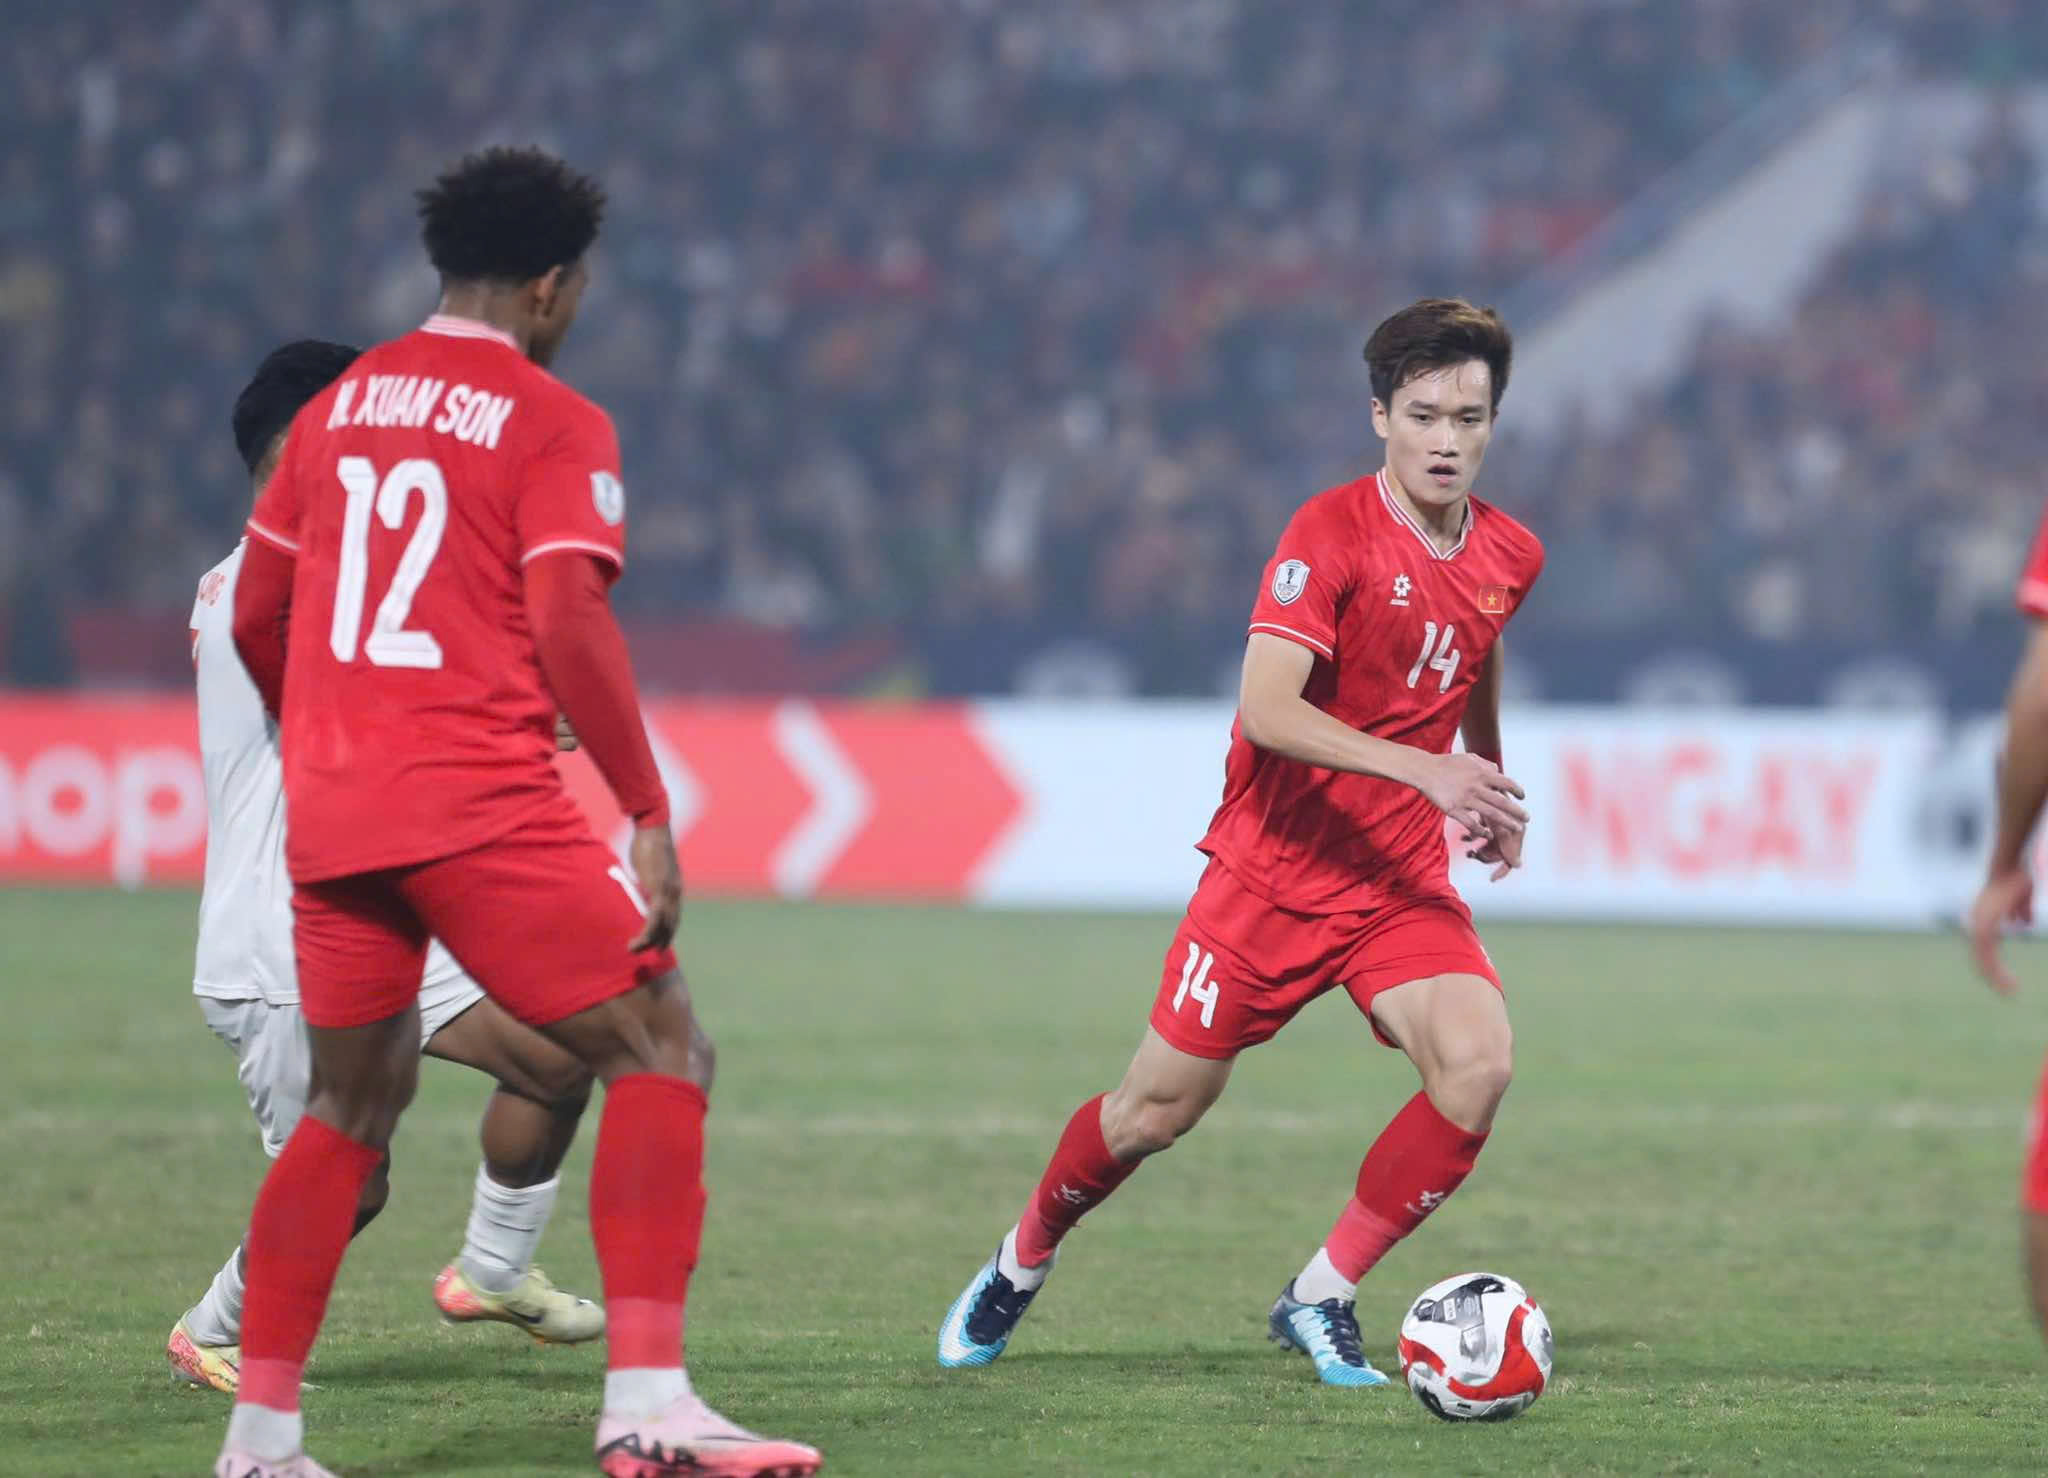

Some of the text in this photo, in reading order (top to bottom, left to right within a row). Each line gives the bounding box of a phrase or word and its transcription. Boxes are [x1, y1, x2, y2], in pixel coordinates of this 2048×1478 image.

[352, 374, 446, 428] XUAN
[433, 383, 515, 450] SON
[330, 456, 447, 669] 12
[1407, 621, 1460, 694] 14
[1557, 738, 1879, 880] NGAY
[1173, 941, 1219, 1028] 14
